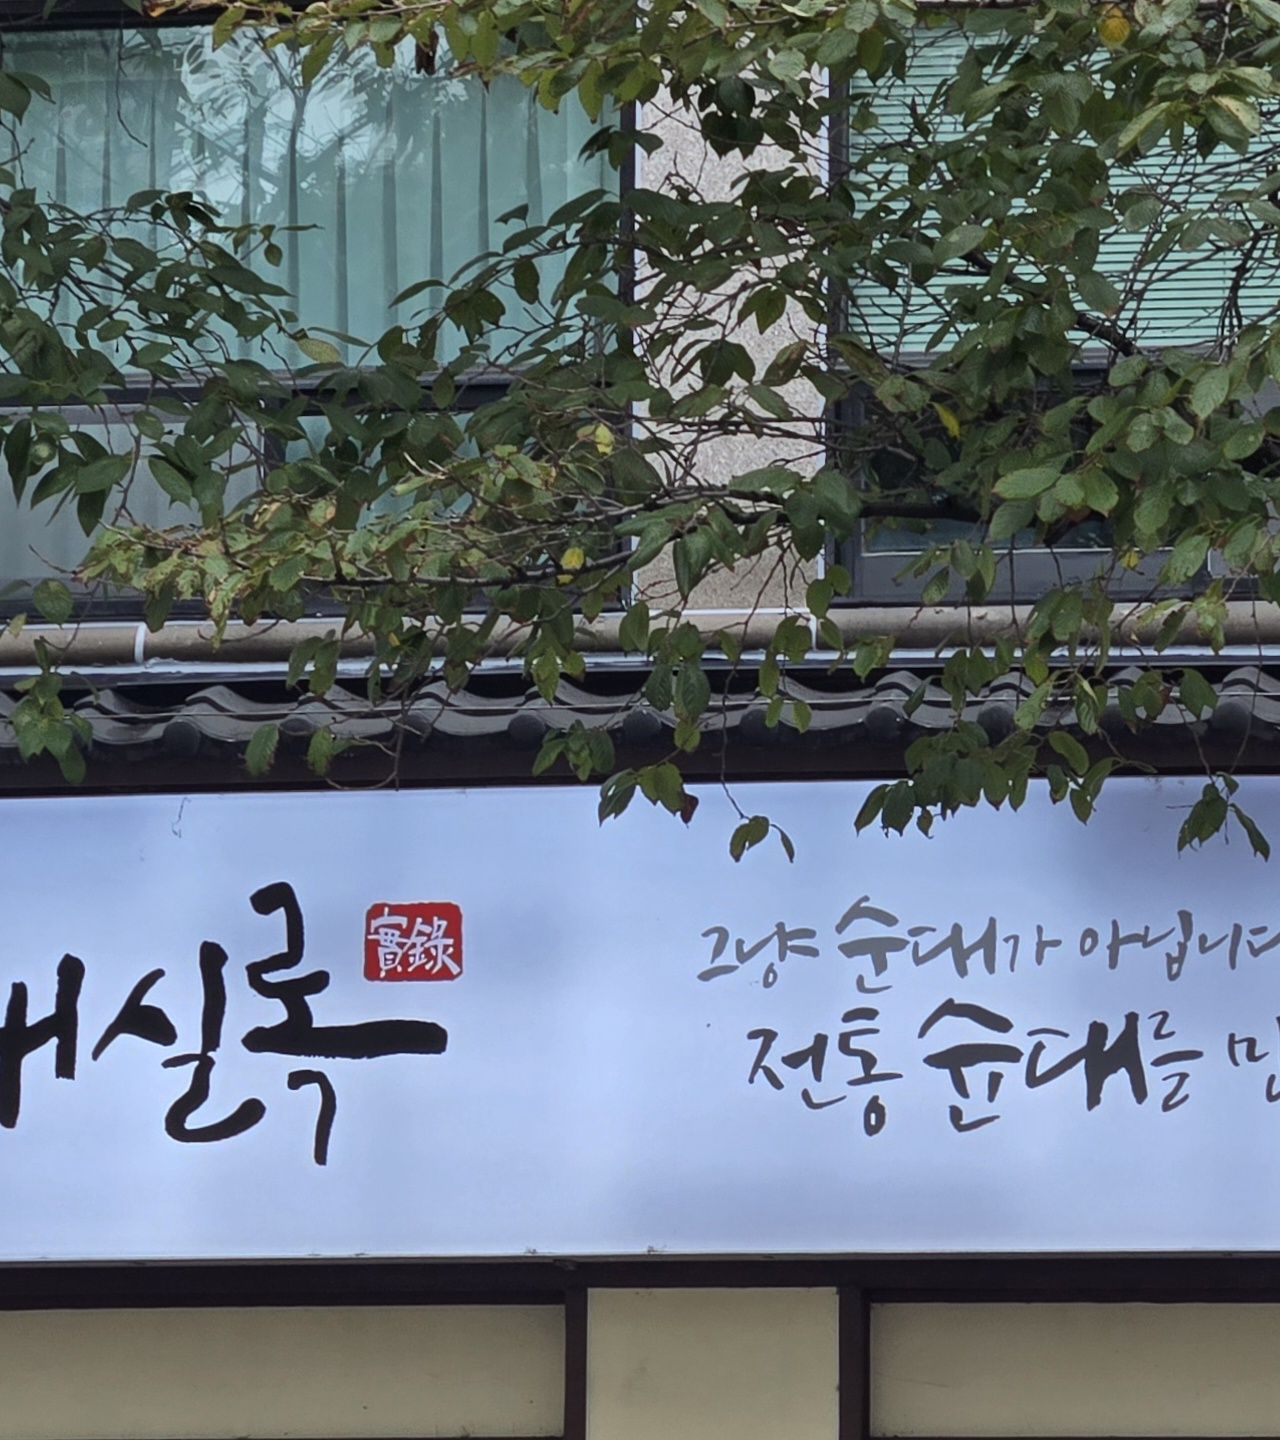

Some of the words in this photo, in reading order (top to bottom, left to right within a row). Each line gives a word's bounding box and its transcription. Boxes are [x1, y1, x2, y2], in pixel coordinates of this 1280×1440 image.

[697, 921, 820, 989] 그냥
[834, 895, 1062, 994] 순대가
[747, 1006, 904, 1136] 전통
[917, 997, 1204, 1132] 순대를
